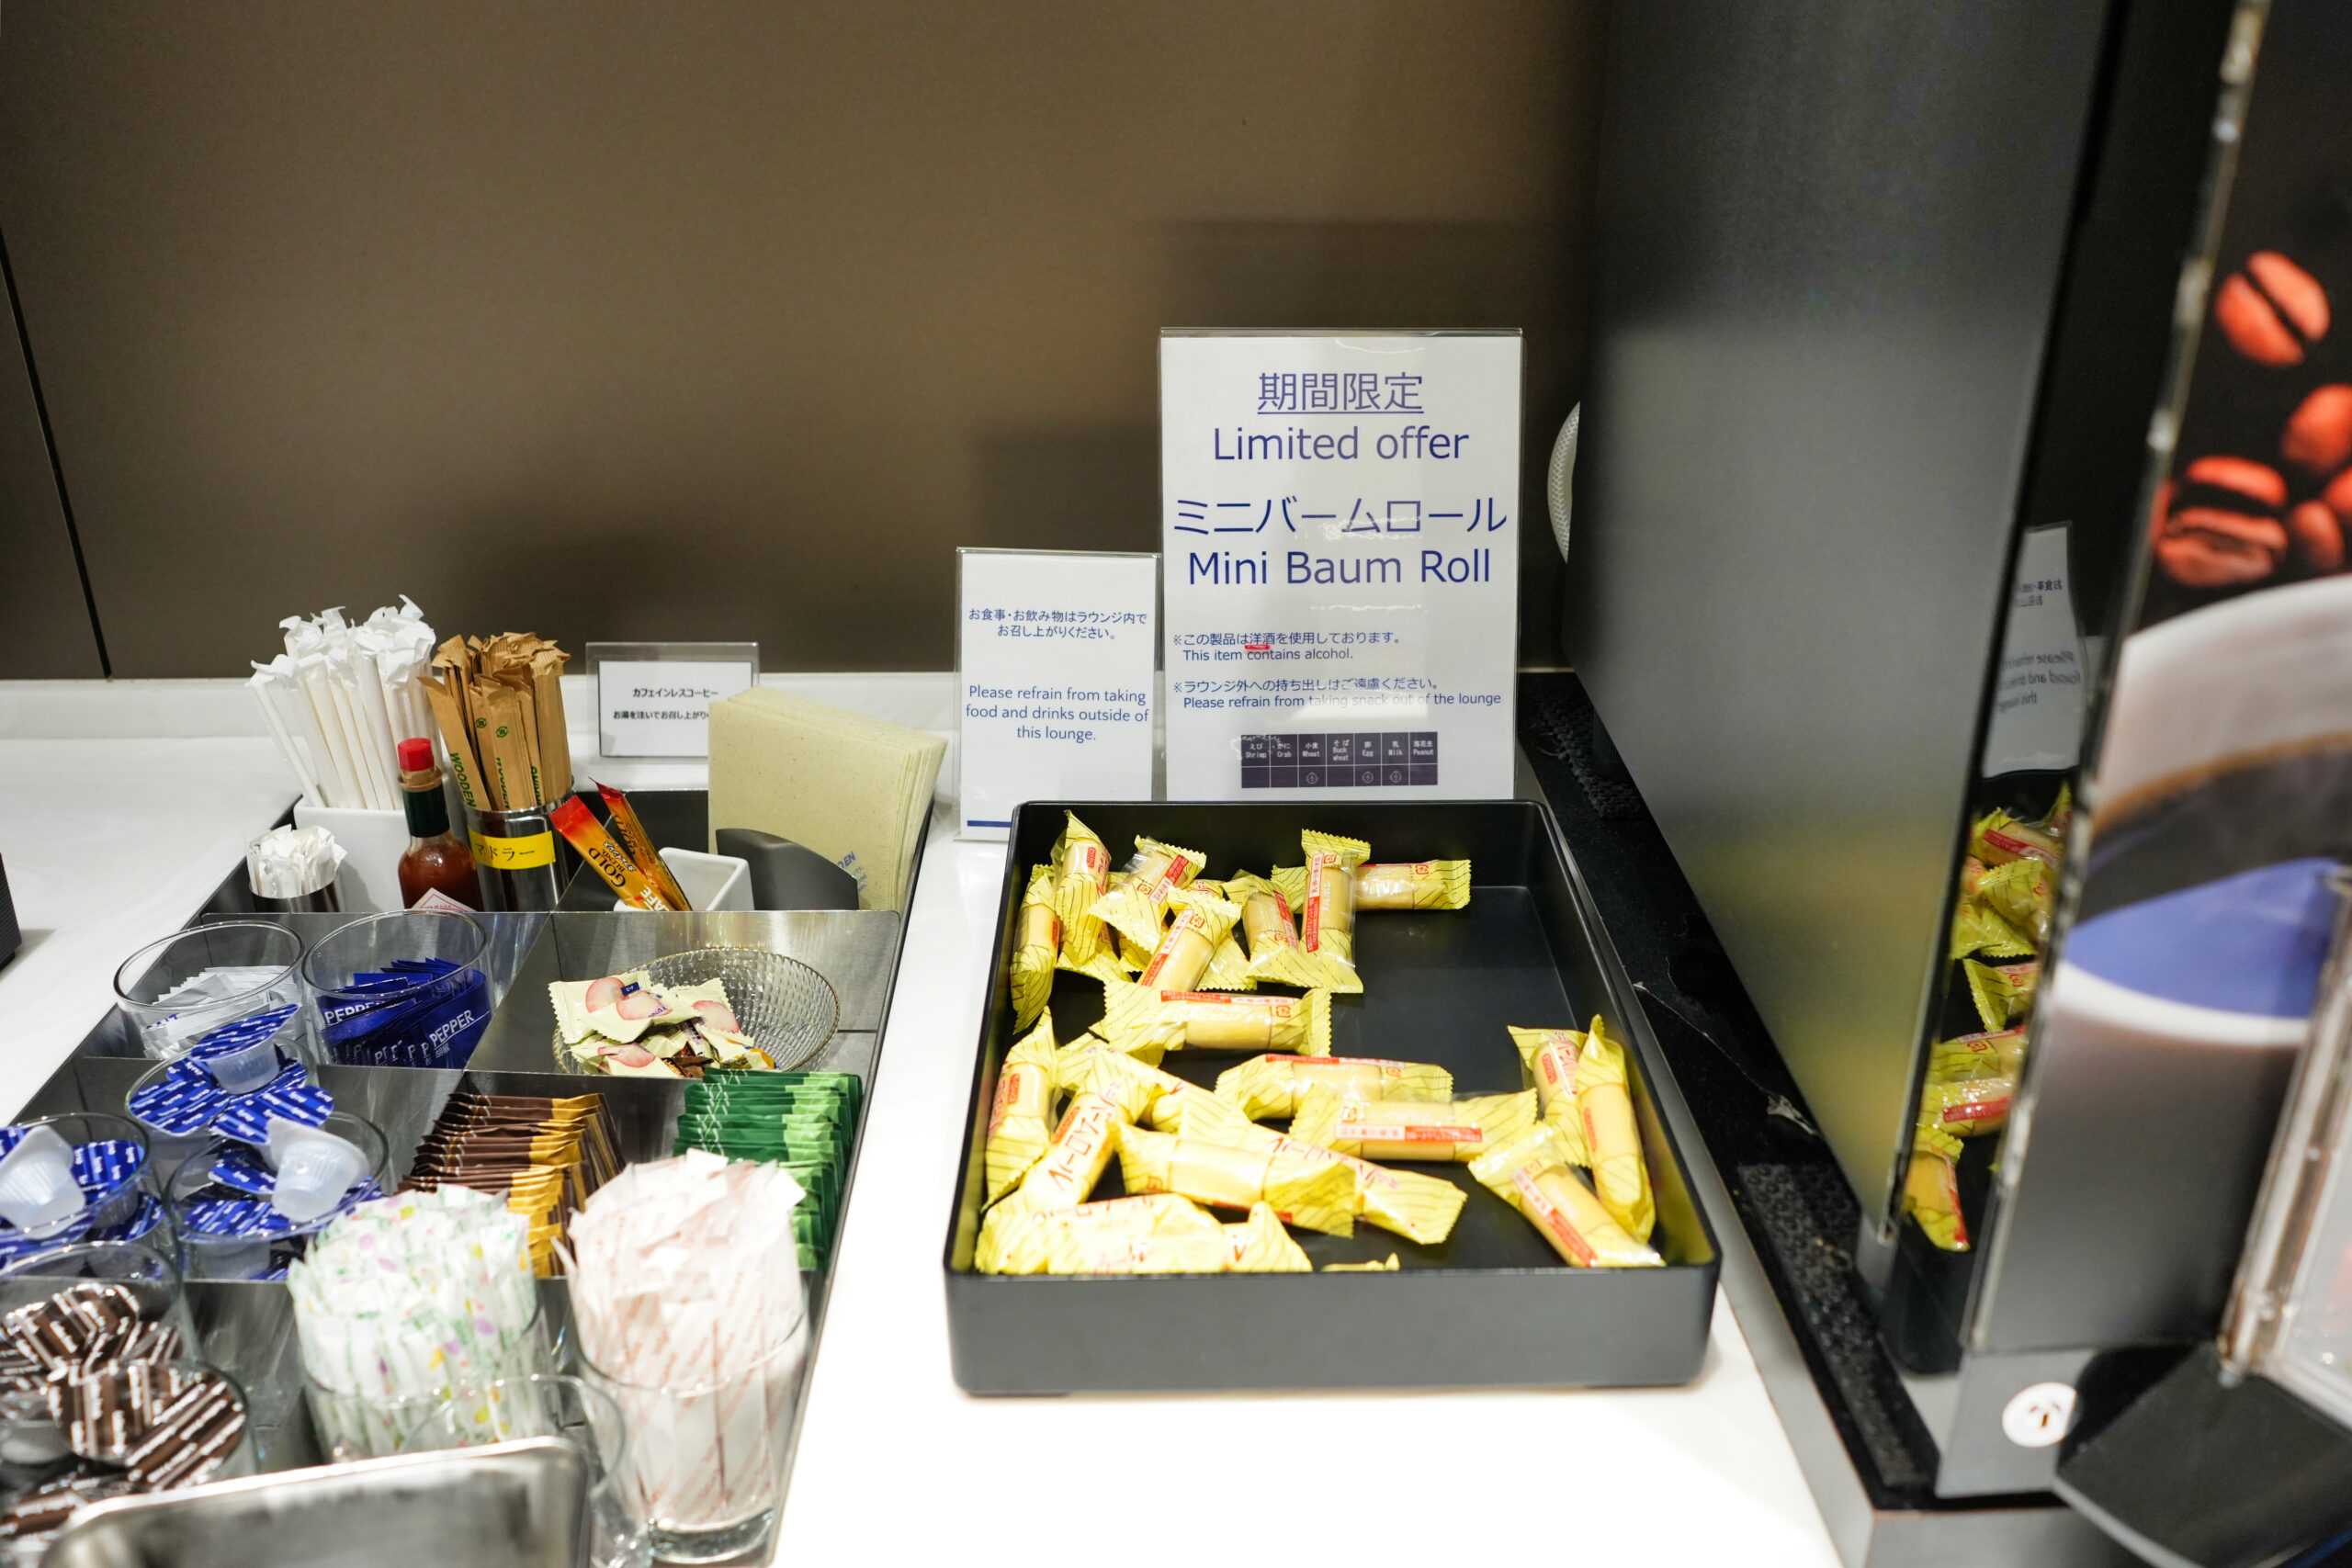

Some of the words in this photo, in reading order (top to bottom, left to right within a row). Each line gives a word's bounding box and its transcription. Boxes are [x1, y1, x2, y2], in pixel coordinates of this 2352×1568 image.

[1258, 372, 1423, 411] 期間限定
[1214, 426, 1359, 460] Limited
[1376, 425, 1470, 460] offer
[1174, 495, 1508, 536] ミニバームロール
[1190, 551, 1268, 585] Mini
[1287, 551, 1402, 585] Baum
[1421, 548, 1490, 583] Roll
[997, 625, 1115, 640] お召し上がりください。
[1183, 649, 1210, 661] This
[1214, 649, 1242, 660] item
[1247, 649, 1301, 660] contains
[1305, 648, 1353, 660] alcohol.
[632, 688, 718, 698] カフェインレスコーヒー
[969, 685, 1012, 699] Please
[1017, 685, 1063, 700] refrain
[1067, 687, 1100, 702] from
[1104, 689, 1147, 706] taking
[1183, 696, 1225, 708] Please
[1228, 695, 1270, 707] refrain
[1274, 694, 1305, 706] from
[1308, 694, 1348, 709] taking
[1352, 694, 1388, 705] snack
[1392, 694, 1413, 705] out
[1434, 694, 1454, 705] the
[1459, 693, 1501, 706] lounge
[966, 704, 998, 718] food
[1001, 705, 1028, 719] and
[1032, 705, 1075, 720] drinks
[1079, 707, 1131, 722] outside
[1135, 708, 1150, 723] of
[1017, 726, 1041, 739] this
[1046, 726, 1096, 743] lounge.
[450, 752, 477, 807] WOODEN
[475, 843, 535, 862] マドラー
[588, 847, 627, 887] GOLD
[429, 1010, 475, 1047] PEPPER
